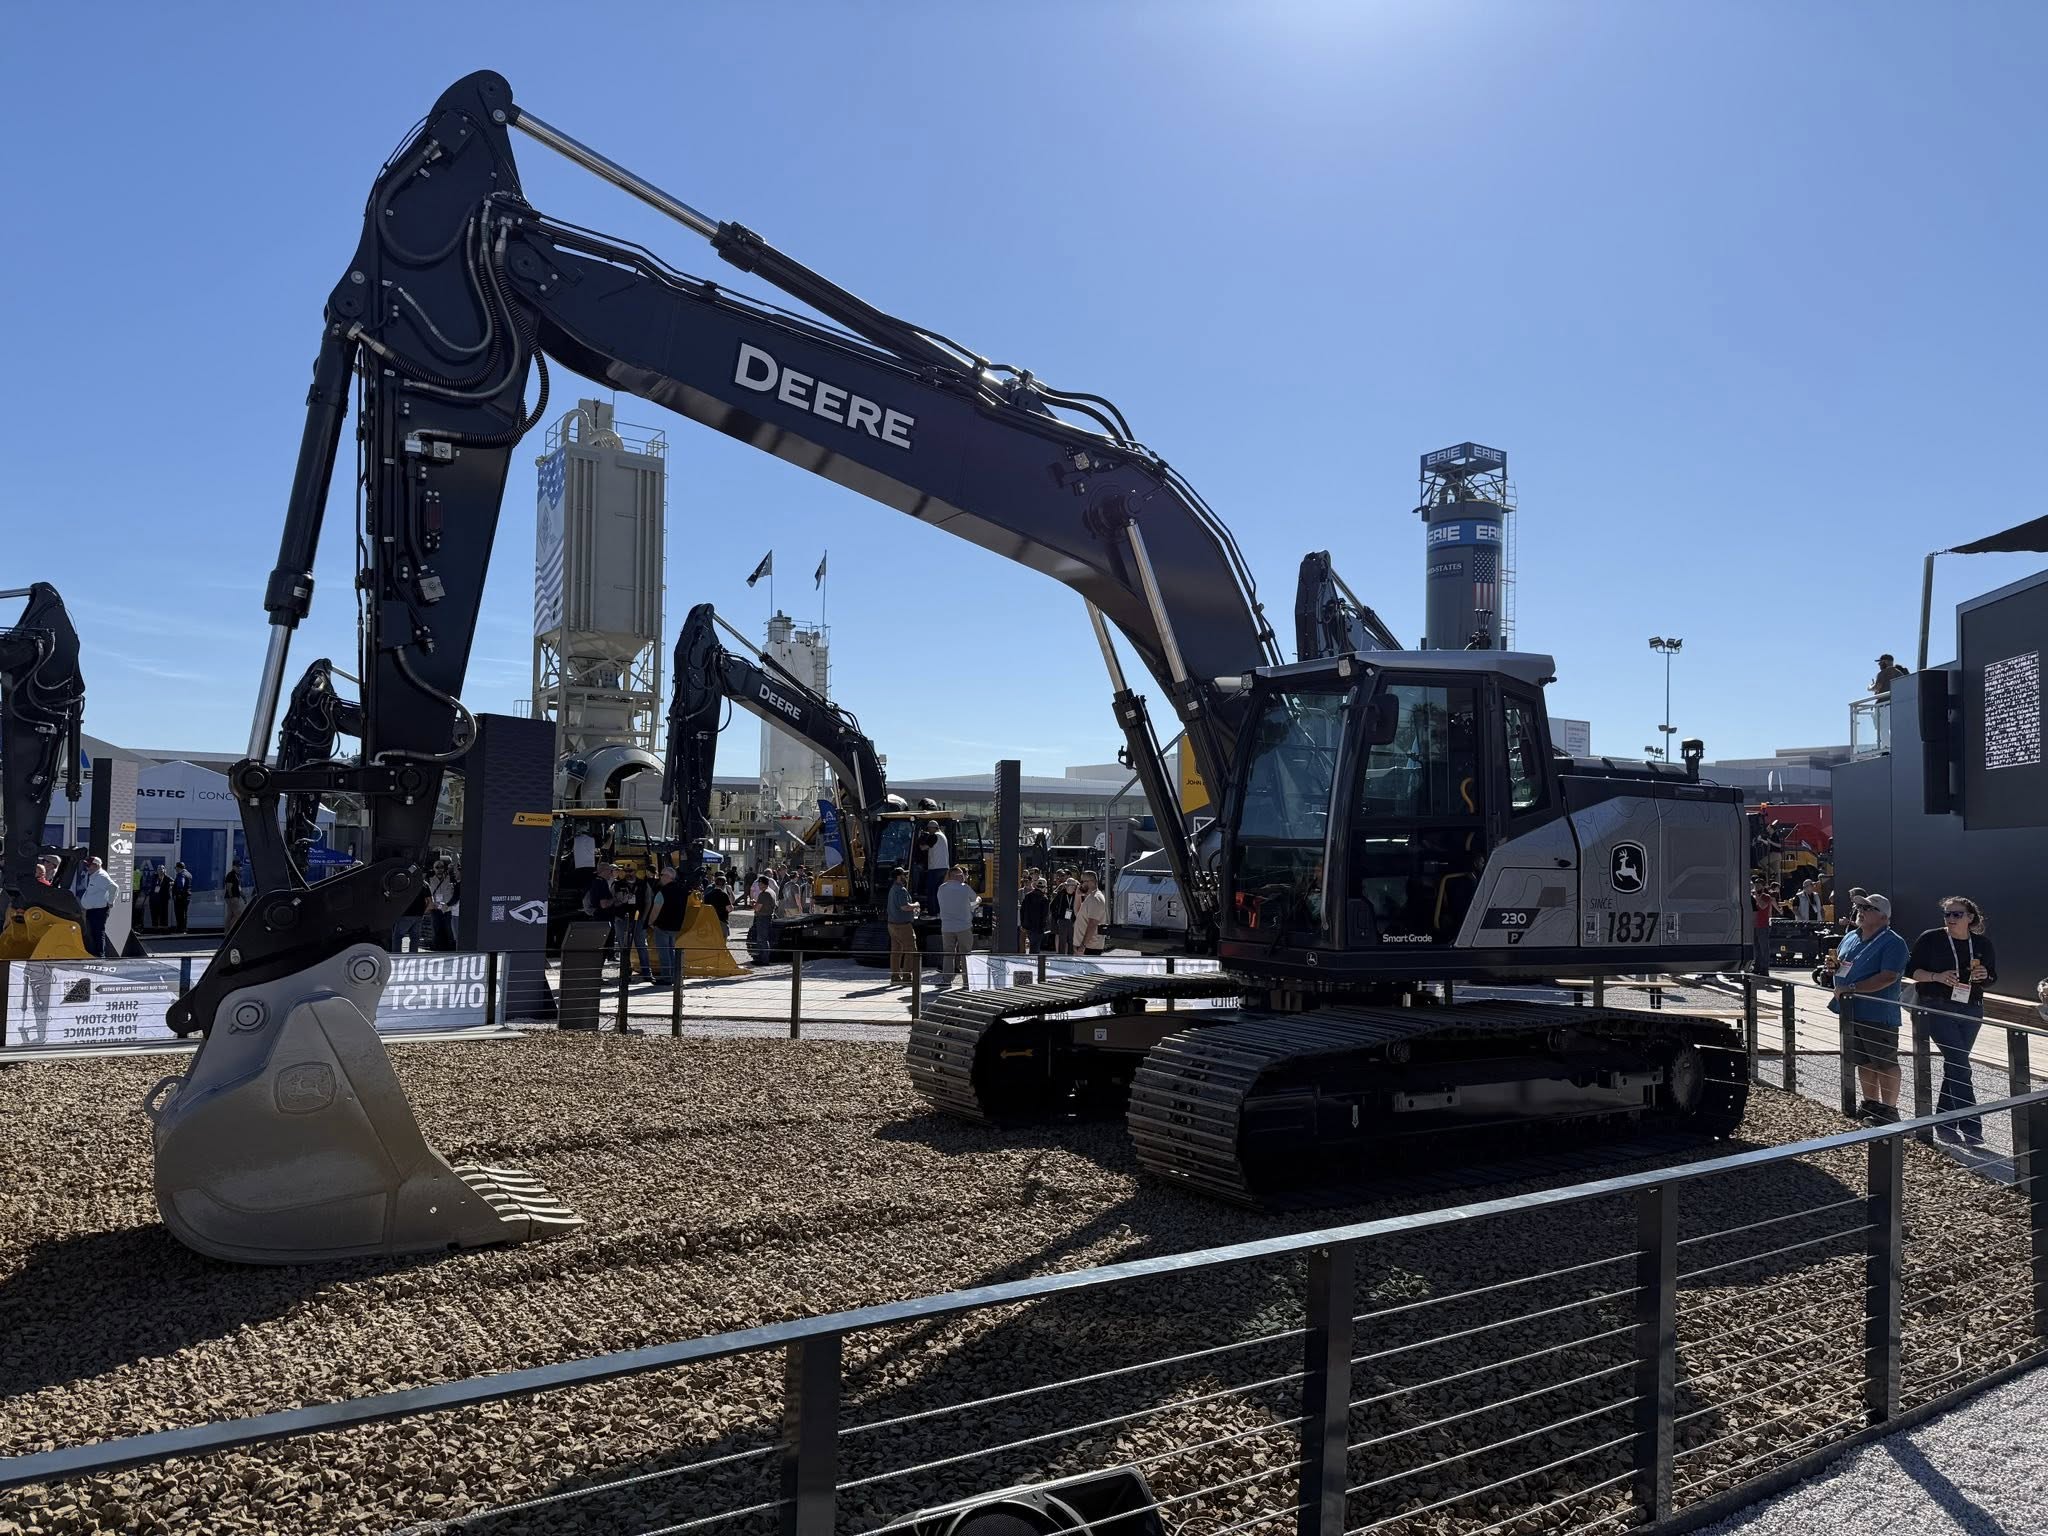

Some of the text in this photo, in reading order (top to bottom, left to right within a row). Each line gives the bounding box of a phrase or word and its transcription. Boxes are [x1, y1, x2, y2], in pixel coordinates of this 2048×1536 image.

[734, 342, 915, 449] DEERE
[1427, 446, 1460, 465] ERIE
[1474, 446, 1502, 462] ERIE
[1428, 526, 1460, 545] ERIE
[758, 683, 802, 721] DEERE
[137, 788, 237, 801] ASTEC CONC
[1590, 898, 1613, 909] SINCE
[1501, 913, 1527, 925] 230
[1607, 911, 1659, 943] 1837
